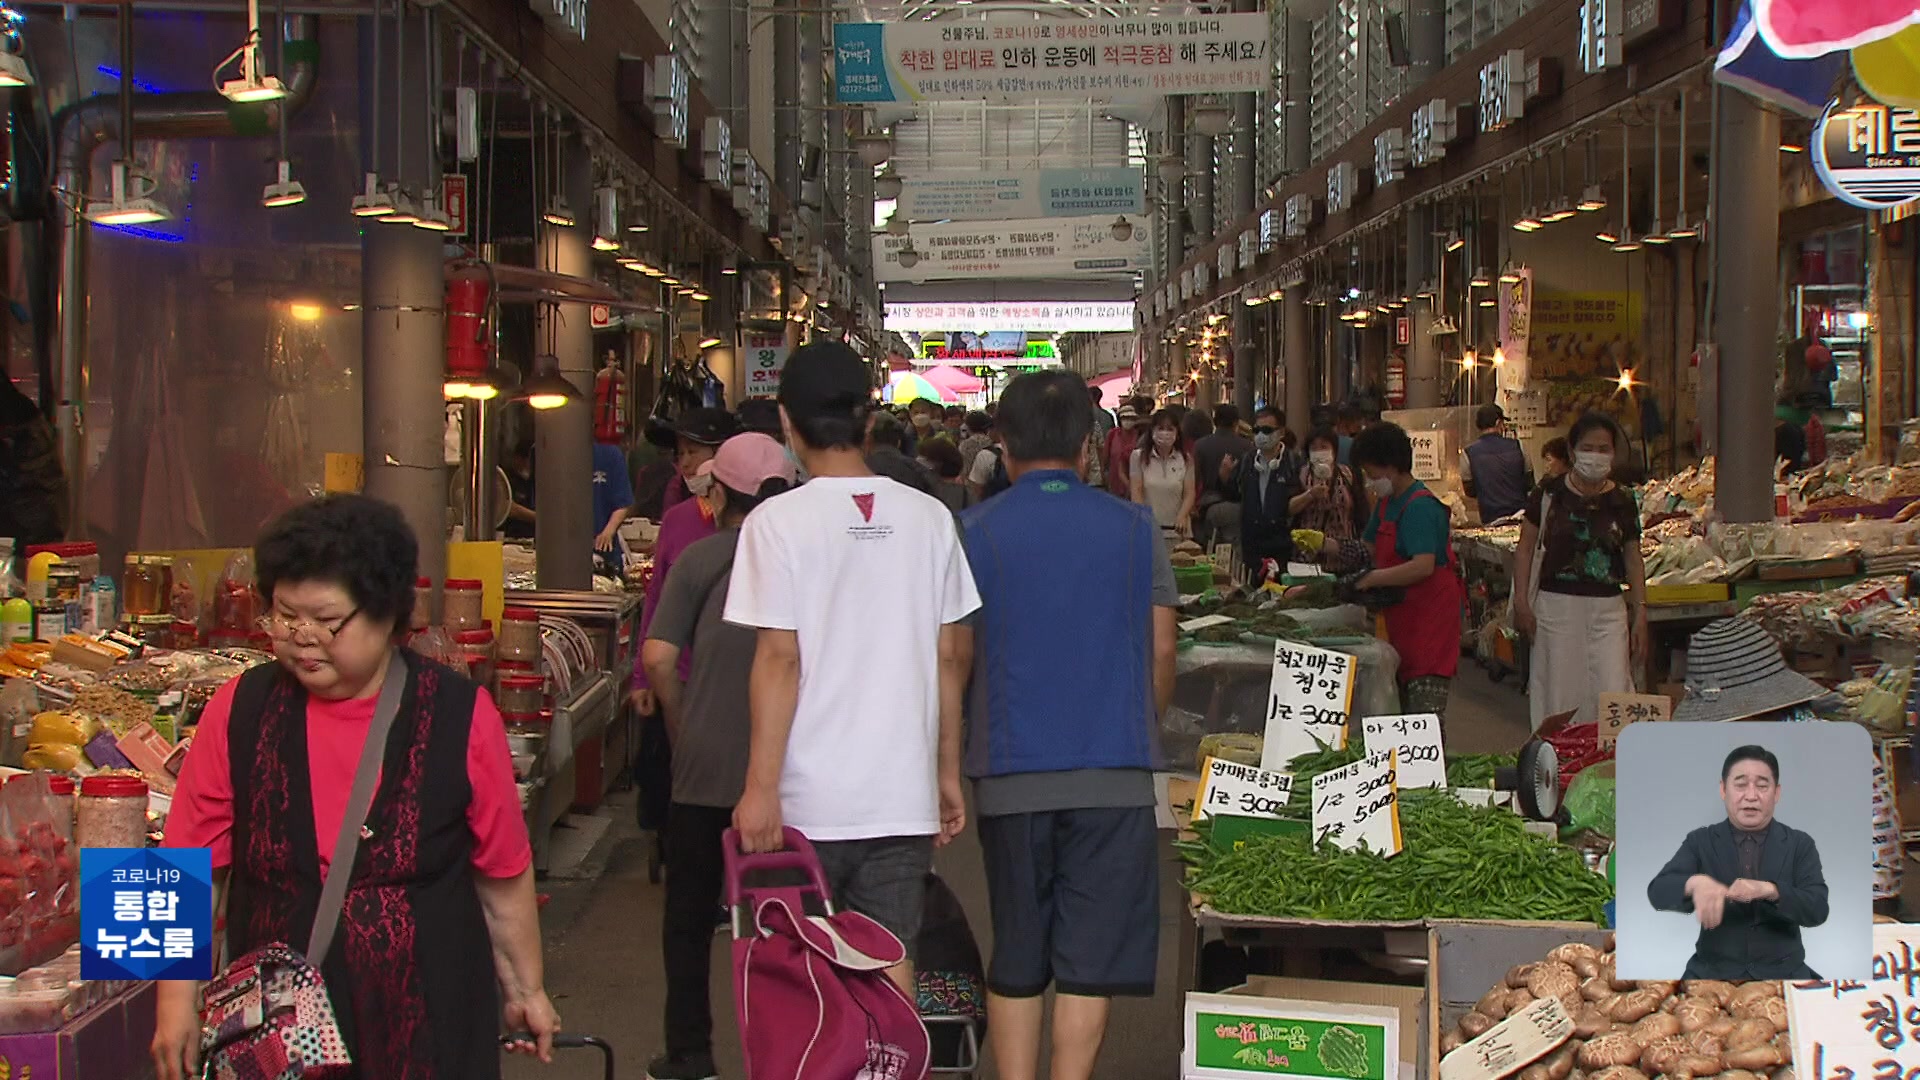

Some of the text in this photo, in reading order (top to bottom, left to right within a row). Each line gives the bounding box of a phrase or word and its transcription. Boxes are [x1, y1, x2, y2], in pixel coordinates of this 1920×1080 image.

[942, 27, 988, 41] 건물주님,
[993, 25, 1051, 38] 코로나19로
[1114, 22, 1146, 37] 너무나
[1151, 21, 1172, 35] 많이
[901, 40, 1266, 72] 착한 임대료 인하 운동에 적극동참 해 주세요!
[1866, 156, 1903, 168] Since
[916, 306, 943, 318] 상인과
[948, 306, 975, 318] 고객을
[979, 306, 998, 318] 위한
[1293, 671, 1341, 701] 청양
[1270, 693, 1294, 721] 1근
[1208, 785, 1231, 805] 1근
[1316, 792, 1346, 814] 1근
